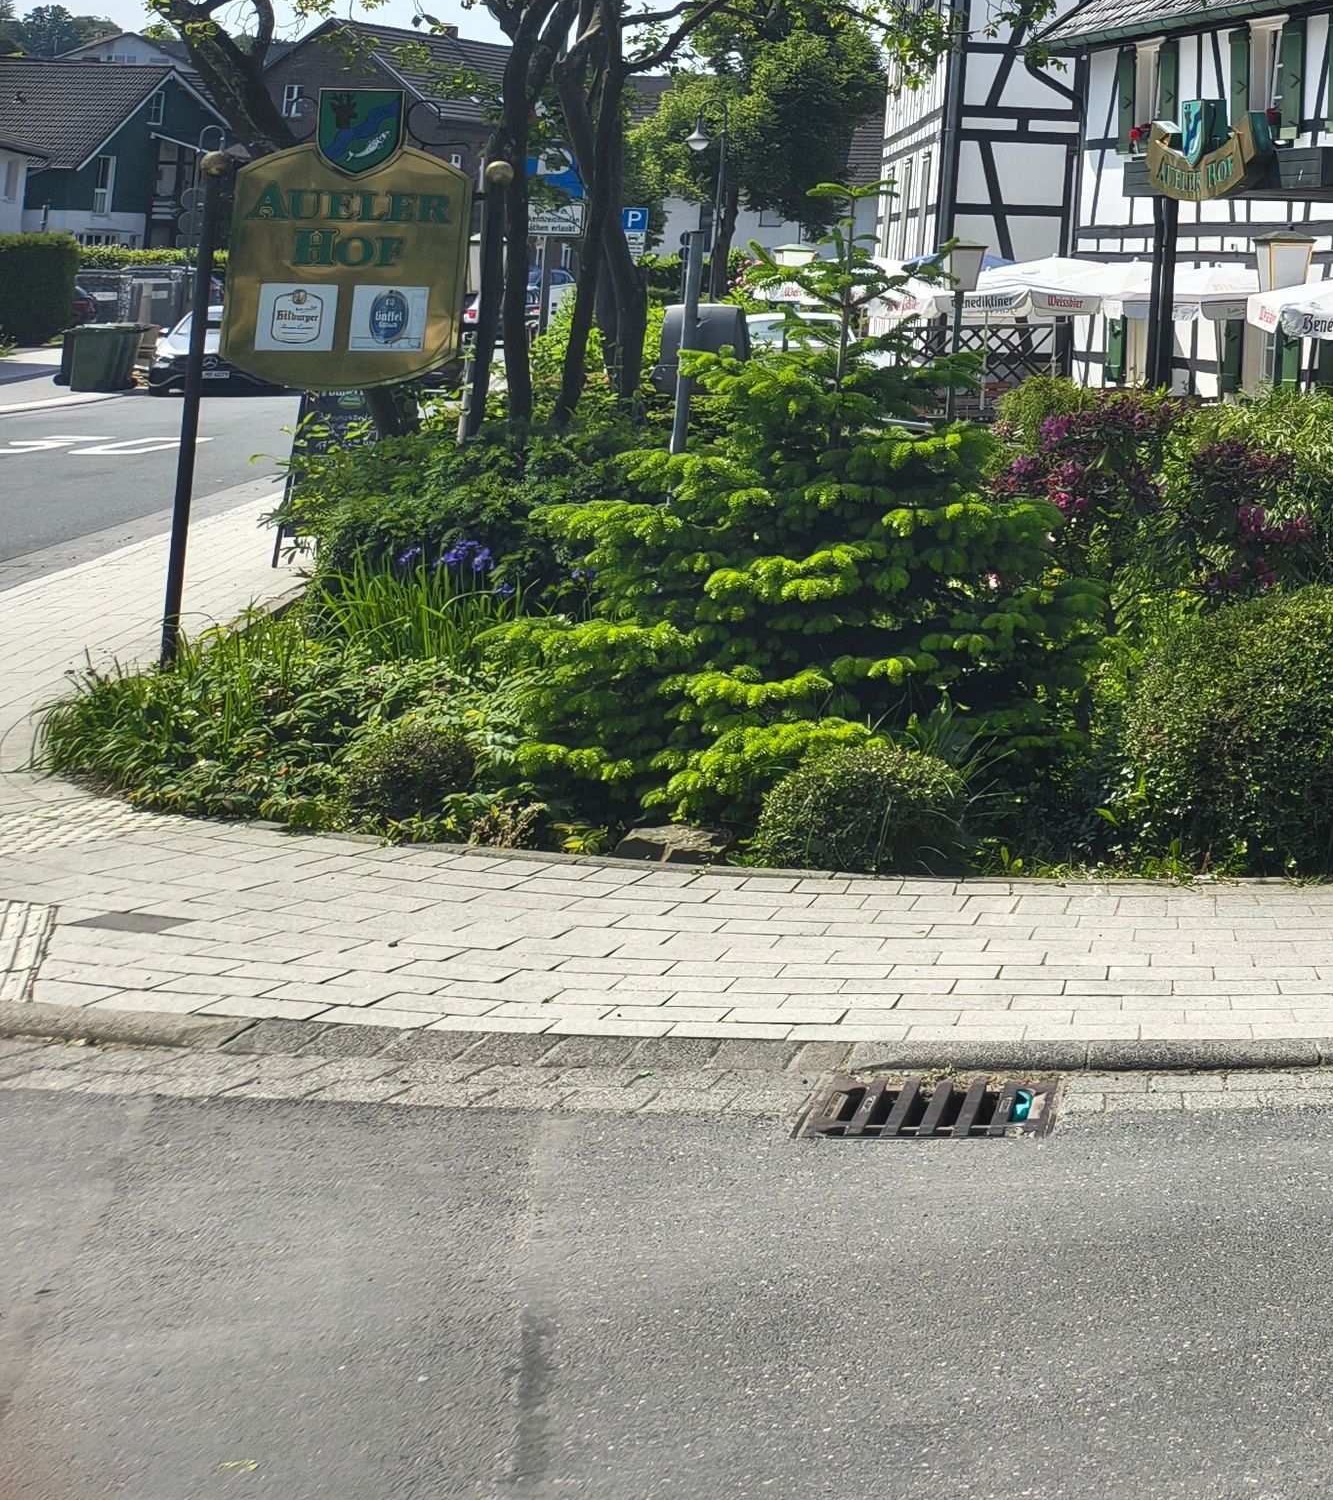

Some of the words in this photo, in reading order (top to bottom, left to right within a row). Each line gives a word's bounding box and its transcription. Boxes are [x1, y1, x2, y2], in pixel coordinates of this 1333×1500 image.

[246, 180, 451, 224] AUELER
[628, 211, 642, 228] P
[293, 228, 406, 267] HOF
[950, 295, 1013, 308] nediktiner
[1047, 297, 1087, 308] Weissbier
[375, 310, 402, 322] Gaffel
